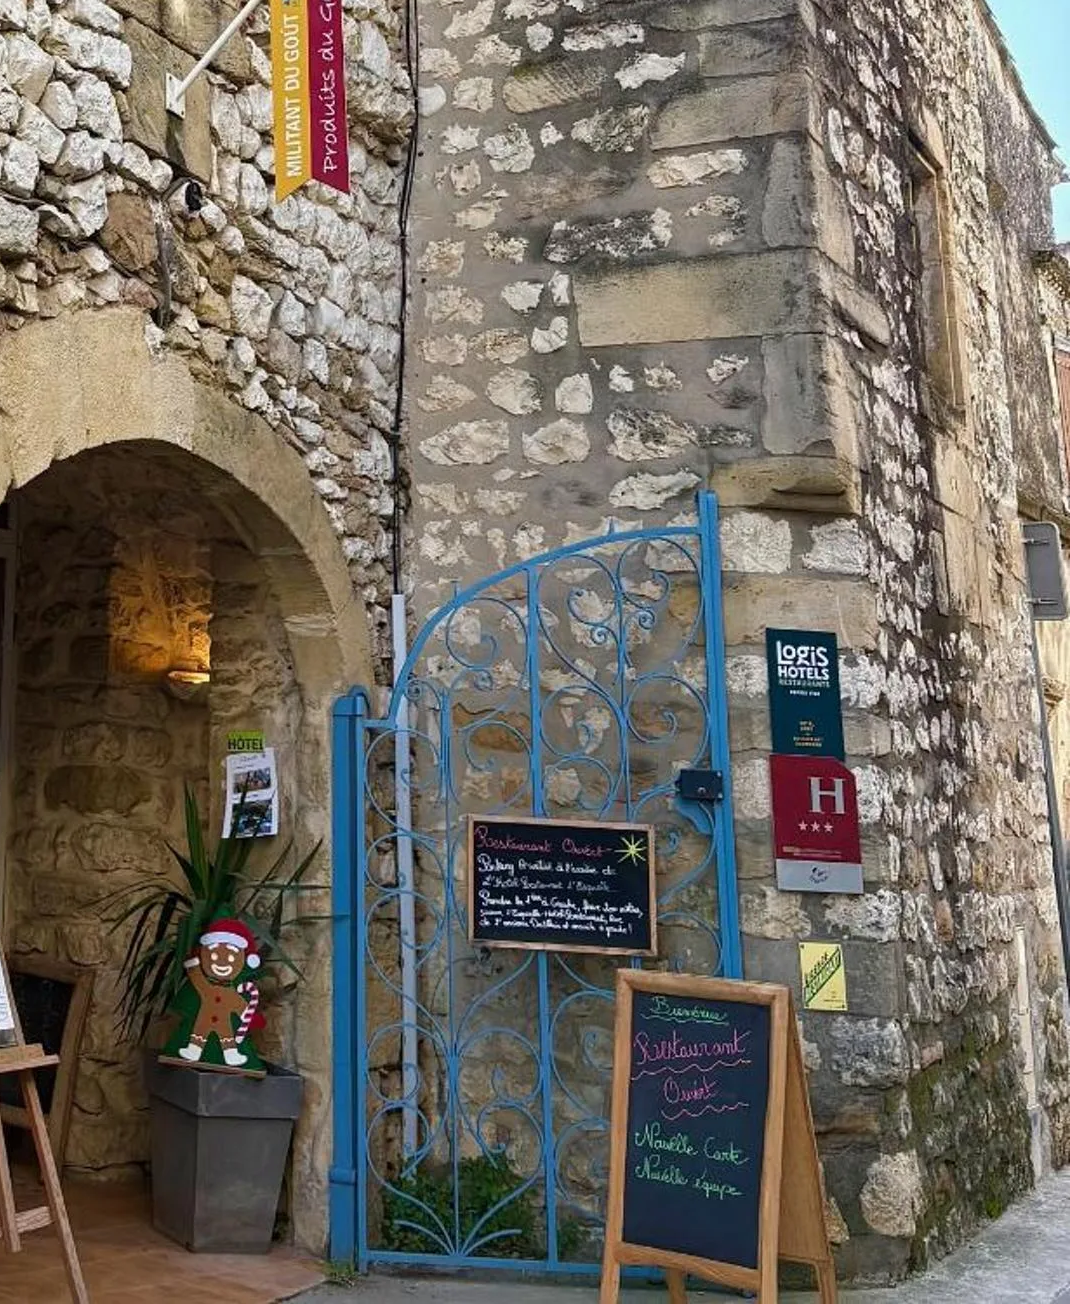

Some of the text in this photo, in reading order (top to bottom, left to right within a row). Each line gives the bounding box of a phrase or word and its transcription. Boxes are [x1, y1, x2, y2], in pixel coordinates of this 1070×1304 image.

[317, 29, 333, 61] du
[284, 64, 300, 91] DU
[285, 98, 302, 178] MILITANT
[317, 68, 338, 174] Produits
[777, 665, 830, 681] HOTELS
[807, 776, 848, 815] H
[634, 1028, 751, 1065] Restaurant
[703, 1136, 750, 1165] Carte
